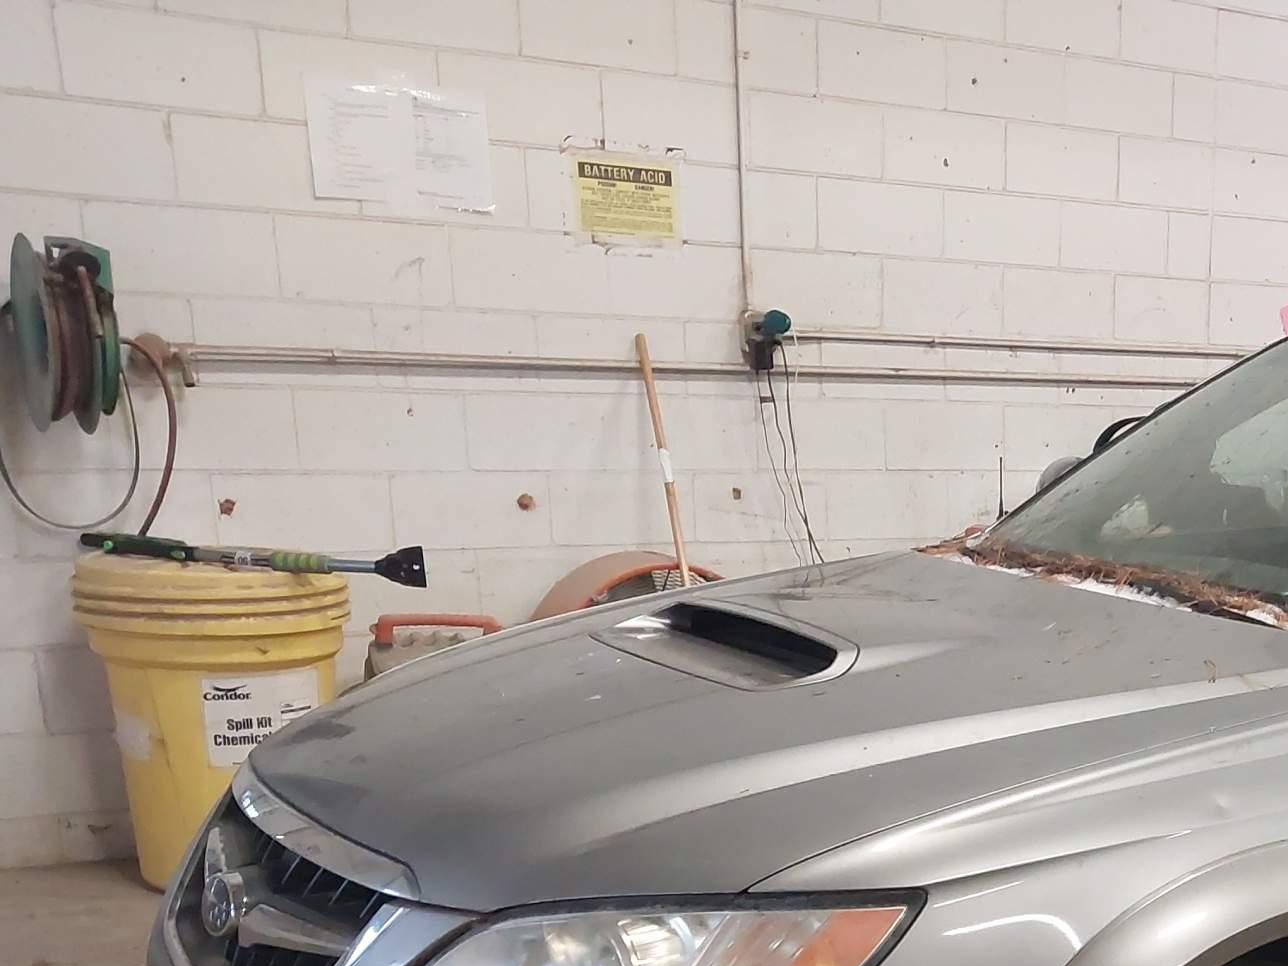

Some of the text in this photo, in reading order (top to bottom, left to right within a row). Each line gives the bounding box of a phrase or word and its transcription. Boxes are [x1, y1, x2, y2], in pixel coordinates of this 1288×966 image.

[584, 164, 666, 184] BATTERY ACID
[203, 691, 252, 701] Condor
[226, 716, 272, 732] Spill Kit
